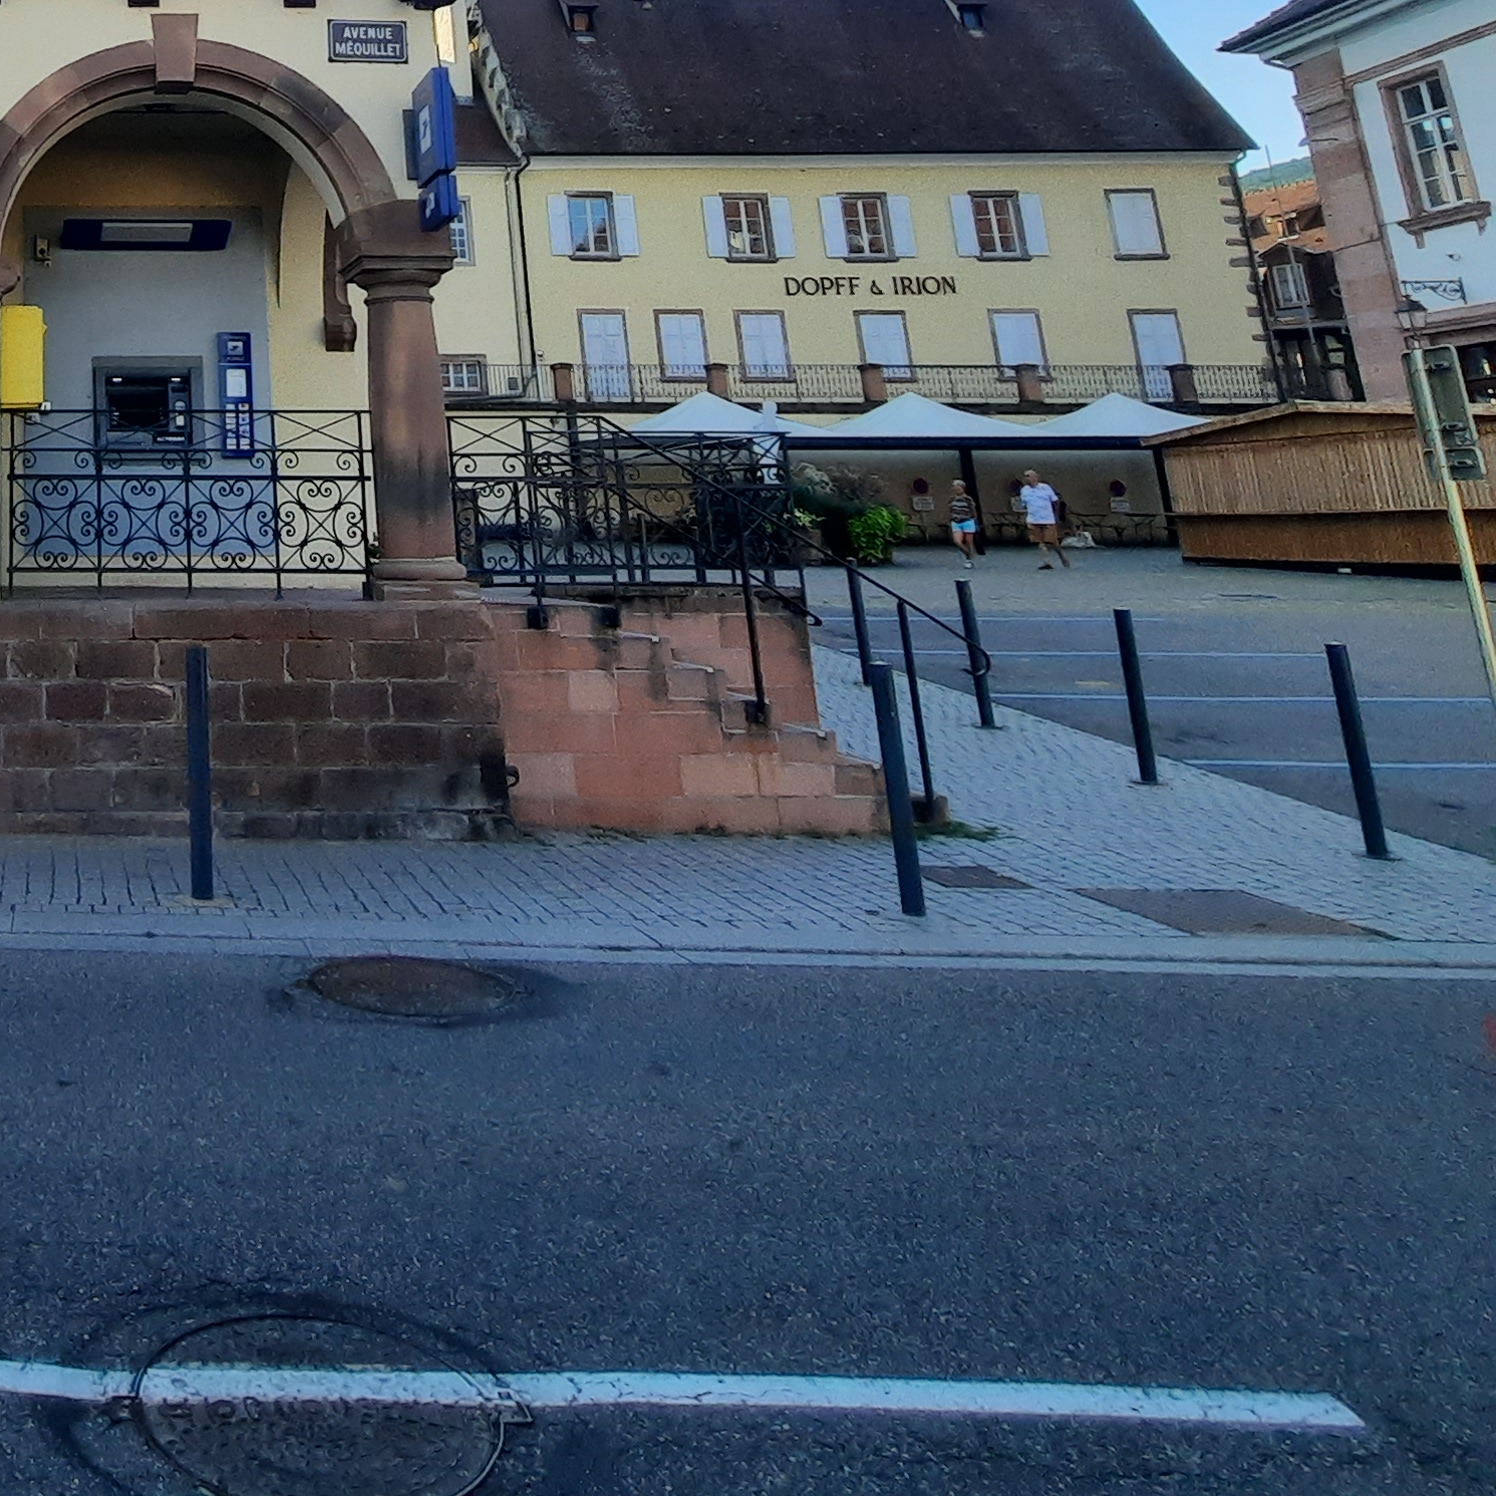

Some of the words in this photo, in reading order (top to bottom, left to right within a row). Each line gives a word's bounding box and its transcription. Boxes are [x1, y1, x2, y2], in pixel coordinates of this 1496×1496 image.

[343, 26, 393, 39] AVENUE
[335, 40, 400, 56] MÉQUILLET
[783, 276, 860, 297] DOPFF
[870, 279, 884, 295] &
[891, 275, 957, 296] IRION
